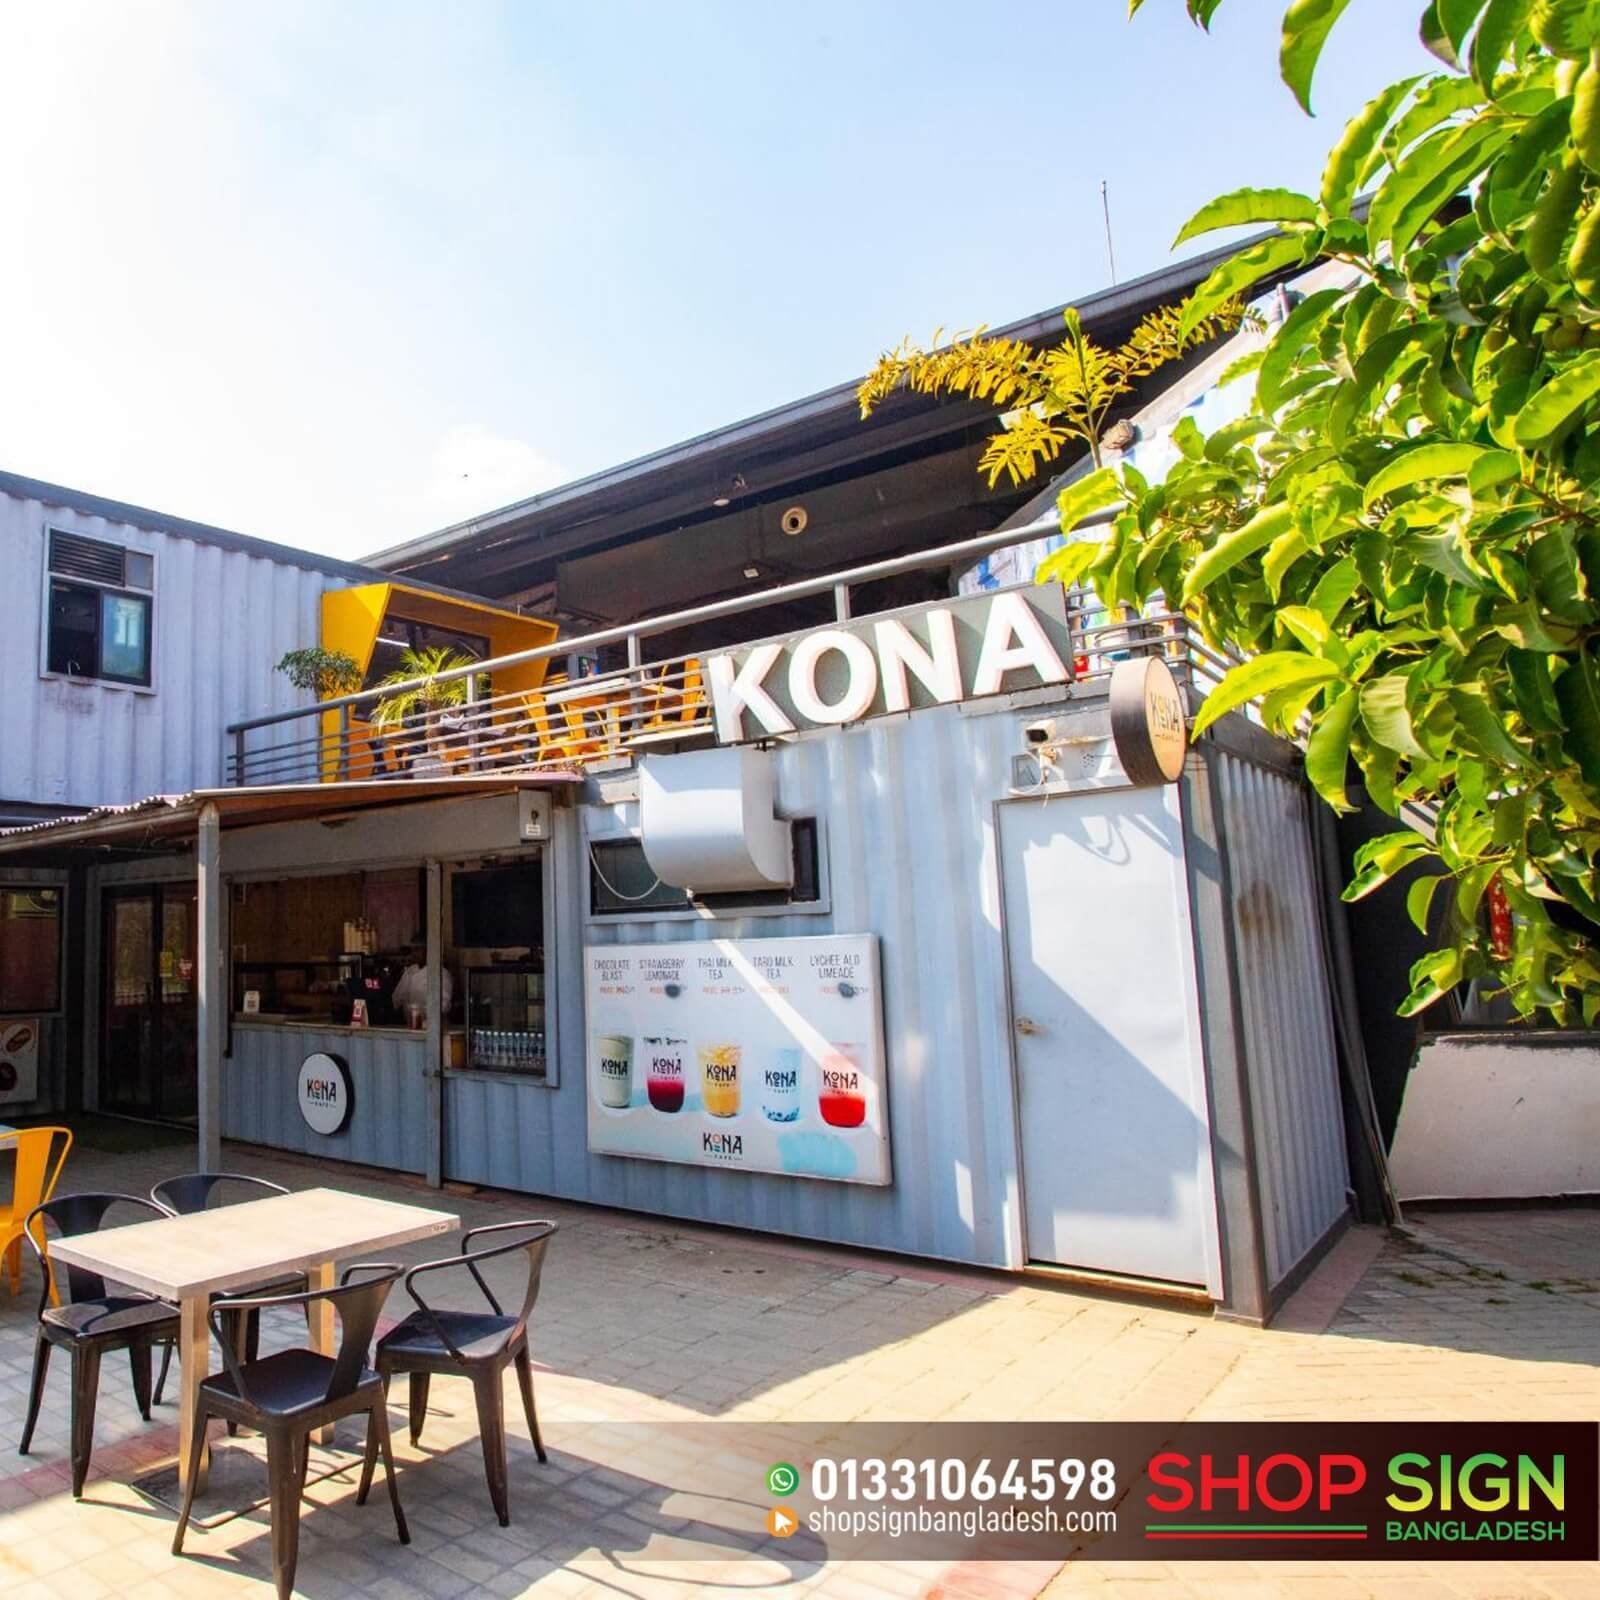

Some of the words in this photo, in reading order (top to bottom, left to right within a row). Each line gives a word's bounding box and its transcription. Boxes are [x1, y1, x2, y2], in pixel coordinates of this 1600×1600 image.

[707, 591, 1068, 745] KONA
[1150, 692, 1180, 734] KONA
[594, 959, 630, 970] CHOCOLATE
[639, 958, 685, 969] STRAWBERRY
[697, 958, 715, 969] THAI
[717, 957, 734, 968] MILK
[753, 957, 774, 967] TARO
[775, 956, 794, 967] MILK
[810, 954, 840, 966] LYCHEE
[602, 971, 623, 981] BLAST
[645, 970, 680, 981] LEMONADE
[709, 970, 724, 980] TEA
[766, 968, 781, 978] TEA
[818, 966, 855, 978] LIMEADE
[601, 1058, 629, 1076] KONA
[652, 1057, 682, 1074] KONA
[706, 1064, 737, 1081] KONA
[765, 1070, 797, 1088] KONA
[823, 1069, 858, 1089] KONA
[307, 1079, 337, 1102] KONA
[703, 1132, 743, 1155] KONA
